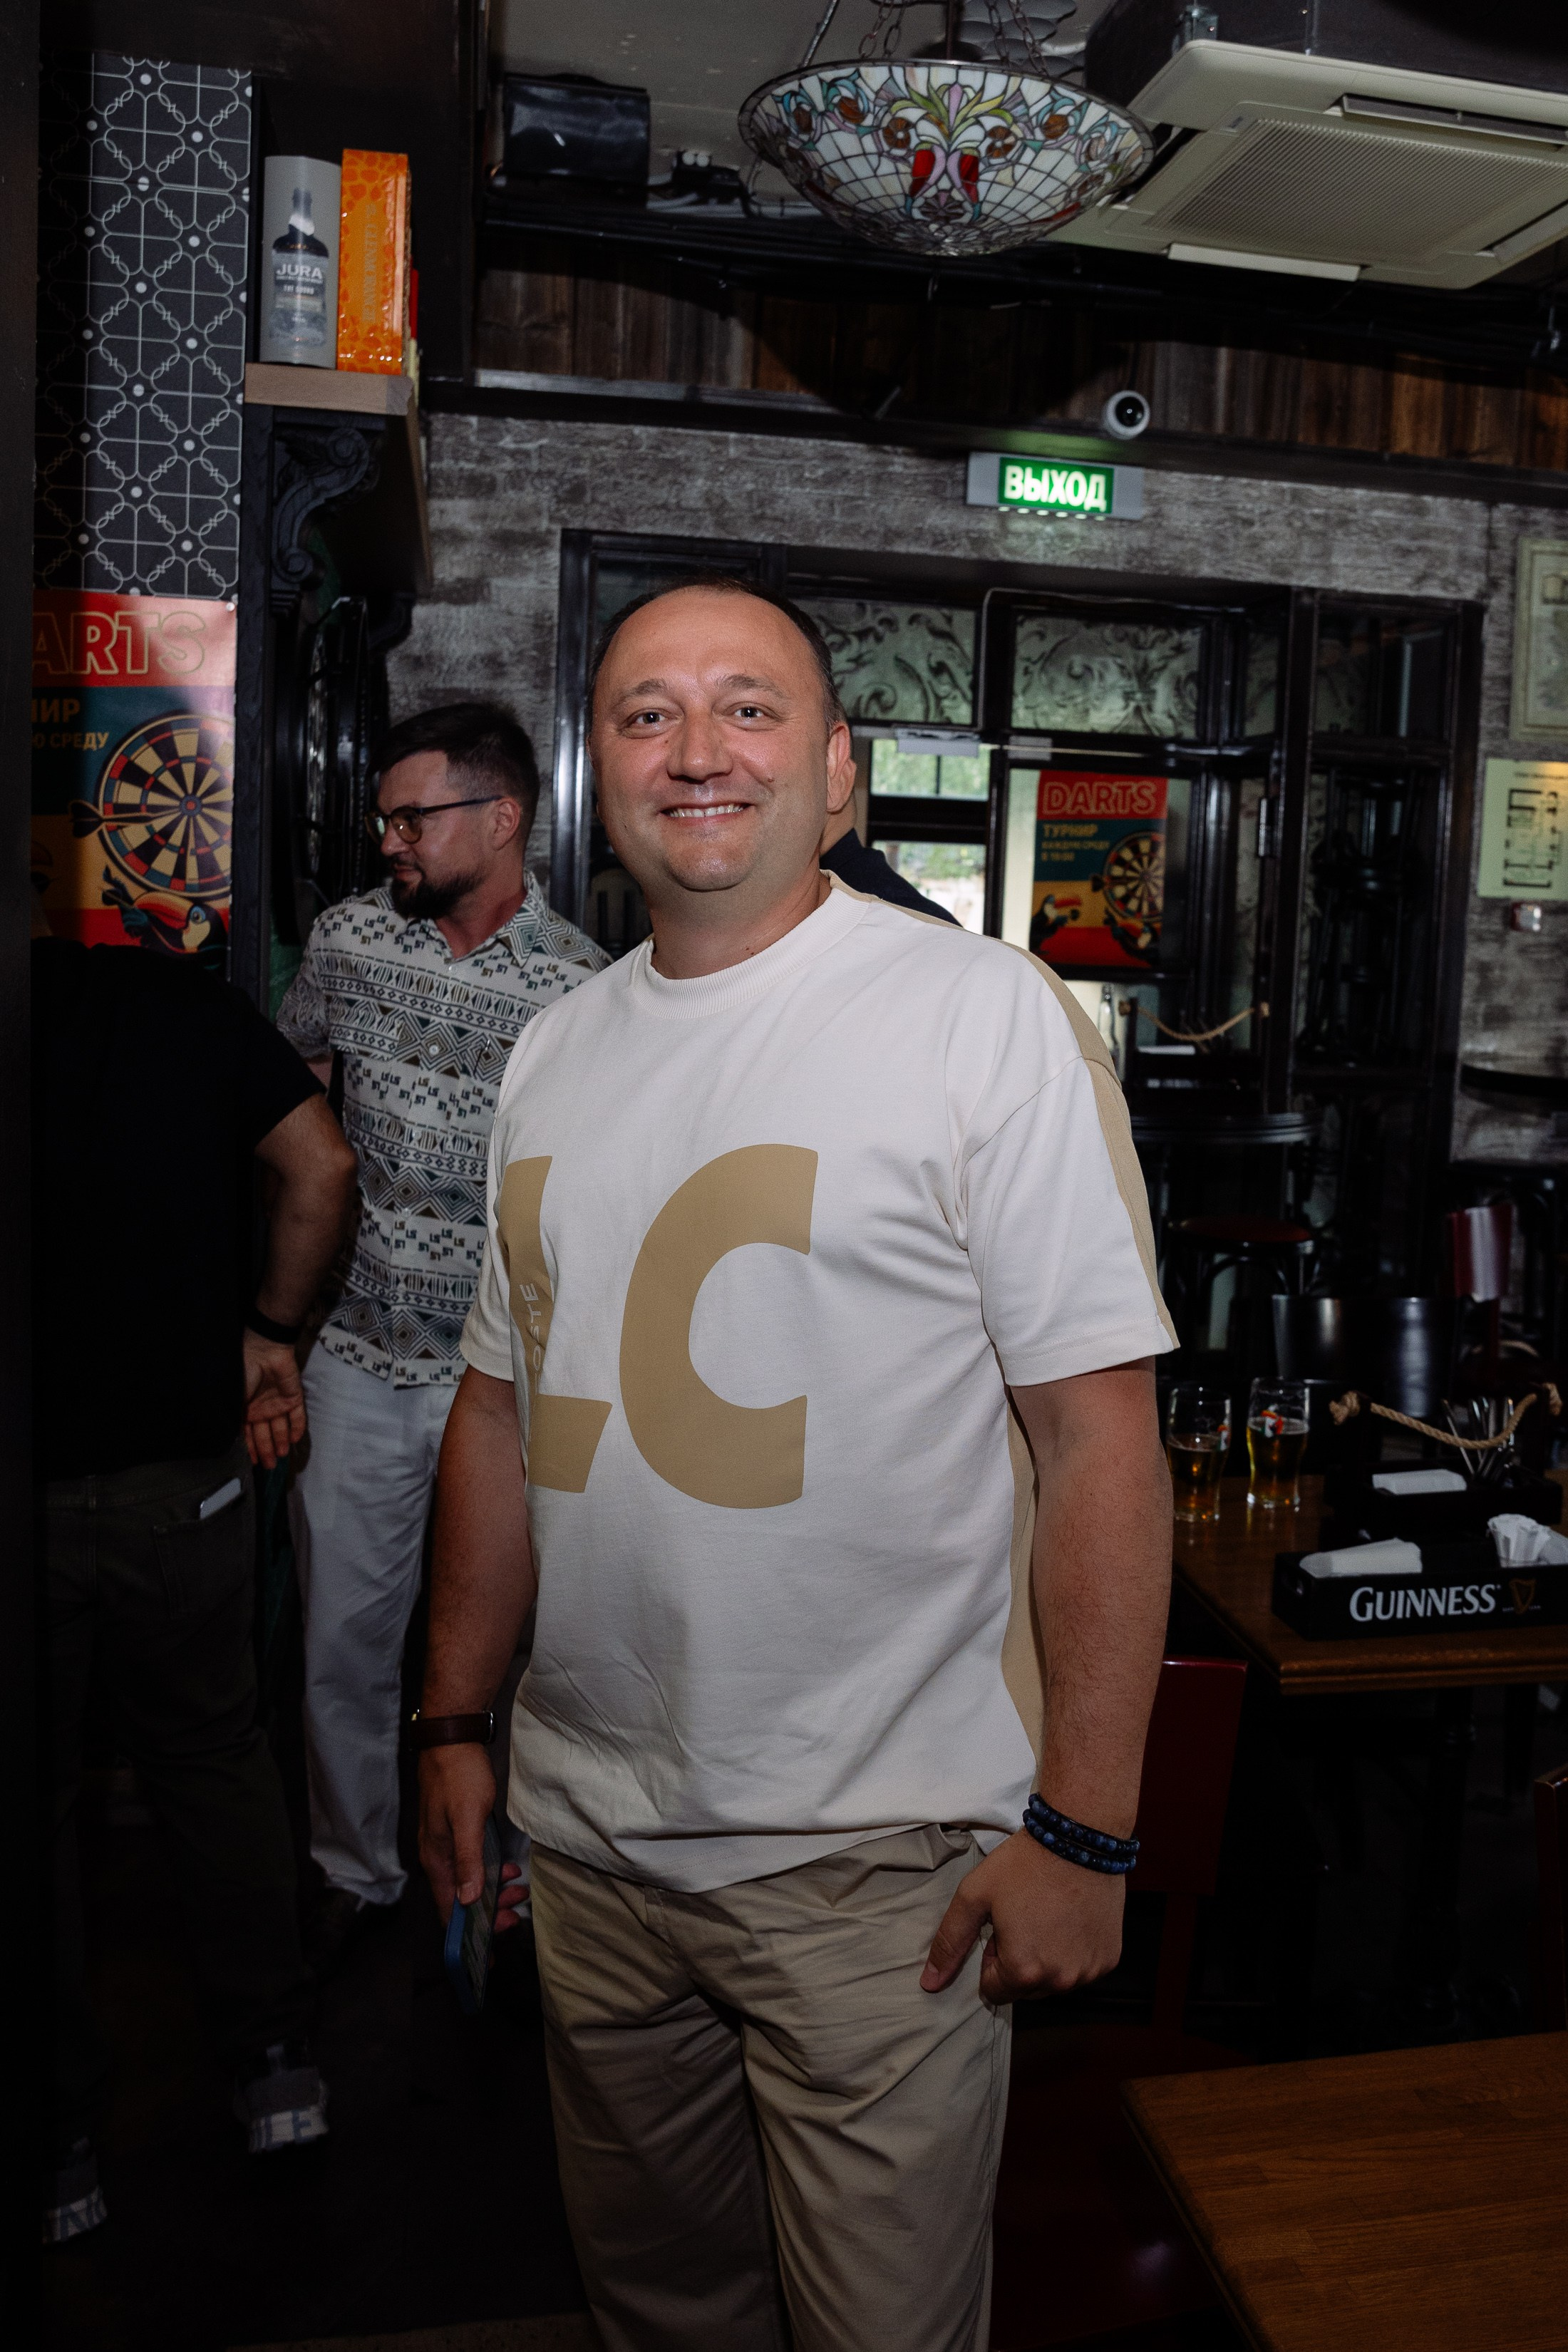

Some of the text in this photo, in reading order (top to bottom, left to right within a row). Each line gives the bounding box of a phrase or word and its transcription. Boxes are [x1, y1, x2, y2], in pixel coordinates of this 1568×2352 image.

[276, 264, 323, 279] JURA
[1004, 465, 1107, 512] ВЫХОД
[49, 731, 110, 752] СРЕДУ
[1042, 781, 1157, 815] DARTS
[1349, 1583, 1497, 1622] GUINNESS
